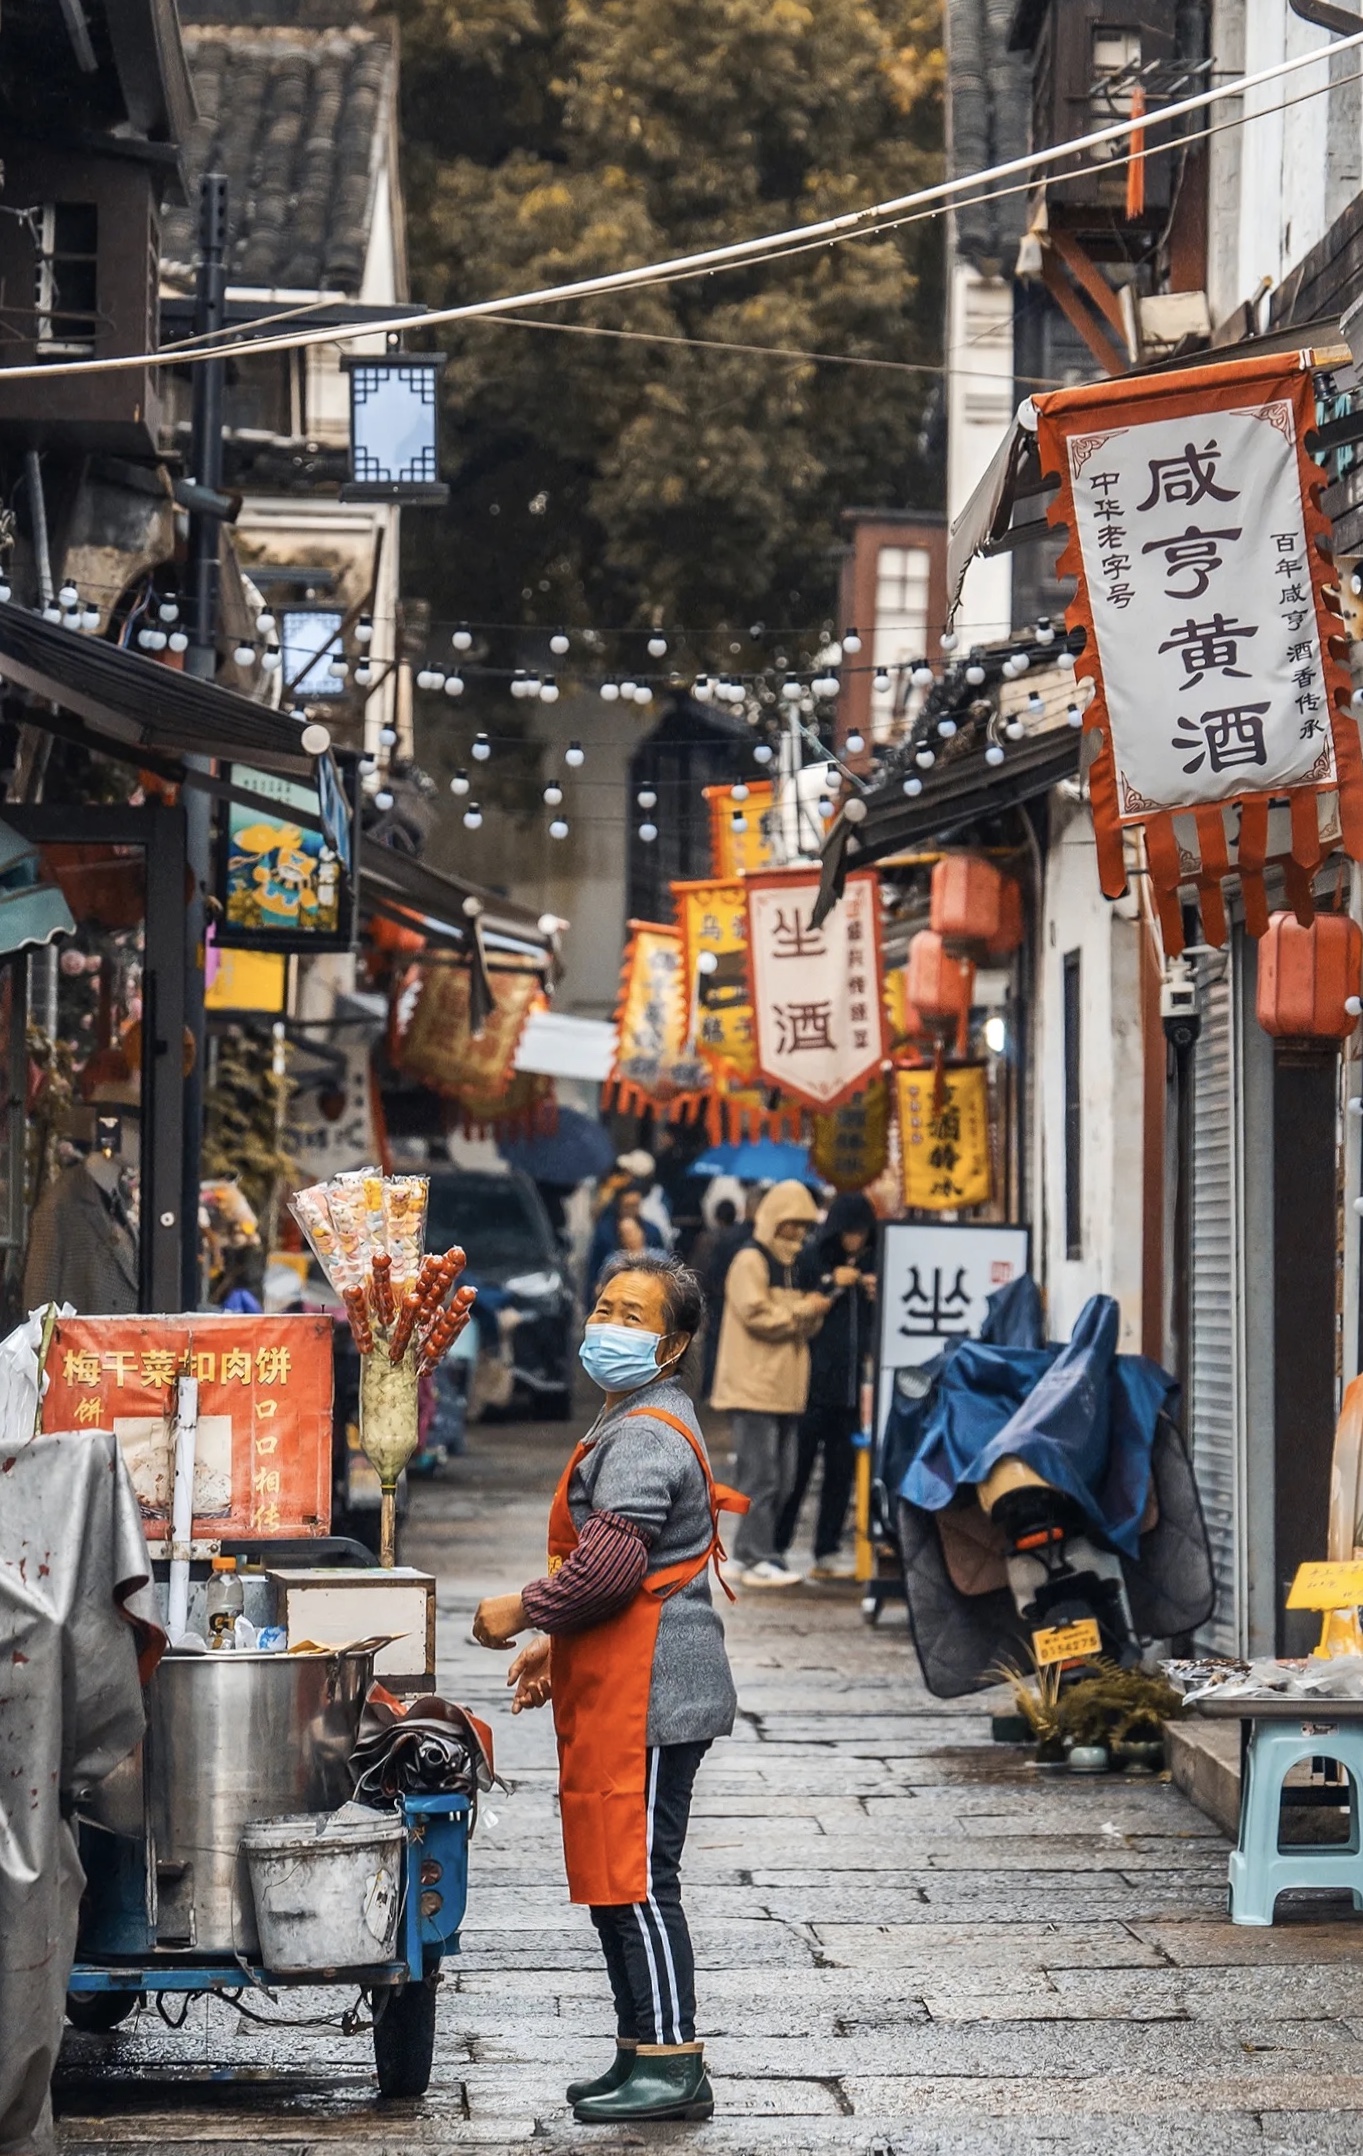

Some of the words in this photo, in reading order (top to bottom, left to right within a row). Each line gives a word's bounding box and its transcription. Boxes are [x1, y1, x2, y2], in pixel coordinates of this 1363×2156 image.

[1089, 472, 1135, 609] 中华老字号
[1136, 439, 1271, 773] 咸亨黄酒
[773, 908, 837, 1054] 坐酒
[63, 1347, 291, 1387] 梅干菜扣肉饼
[899, 1265, 971, 1337] 坐
[253, 1399, 281, 1533] 口口相传
